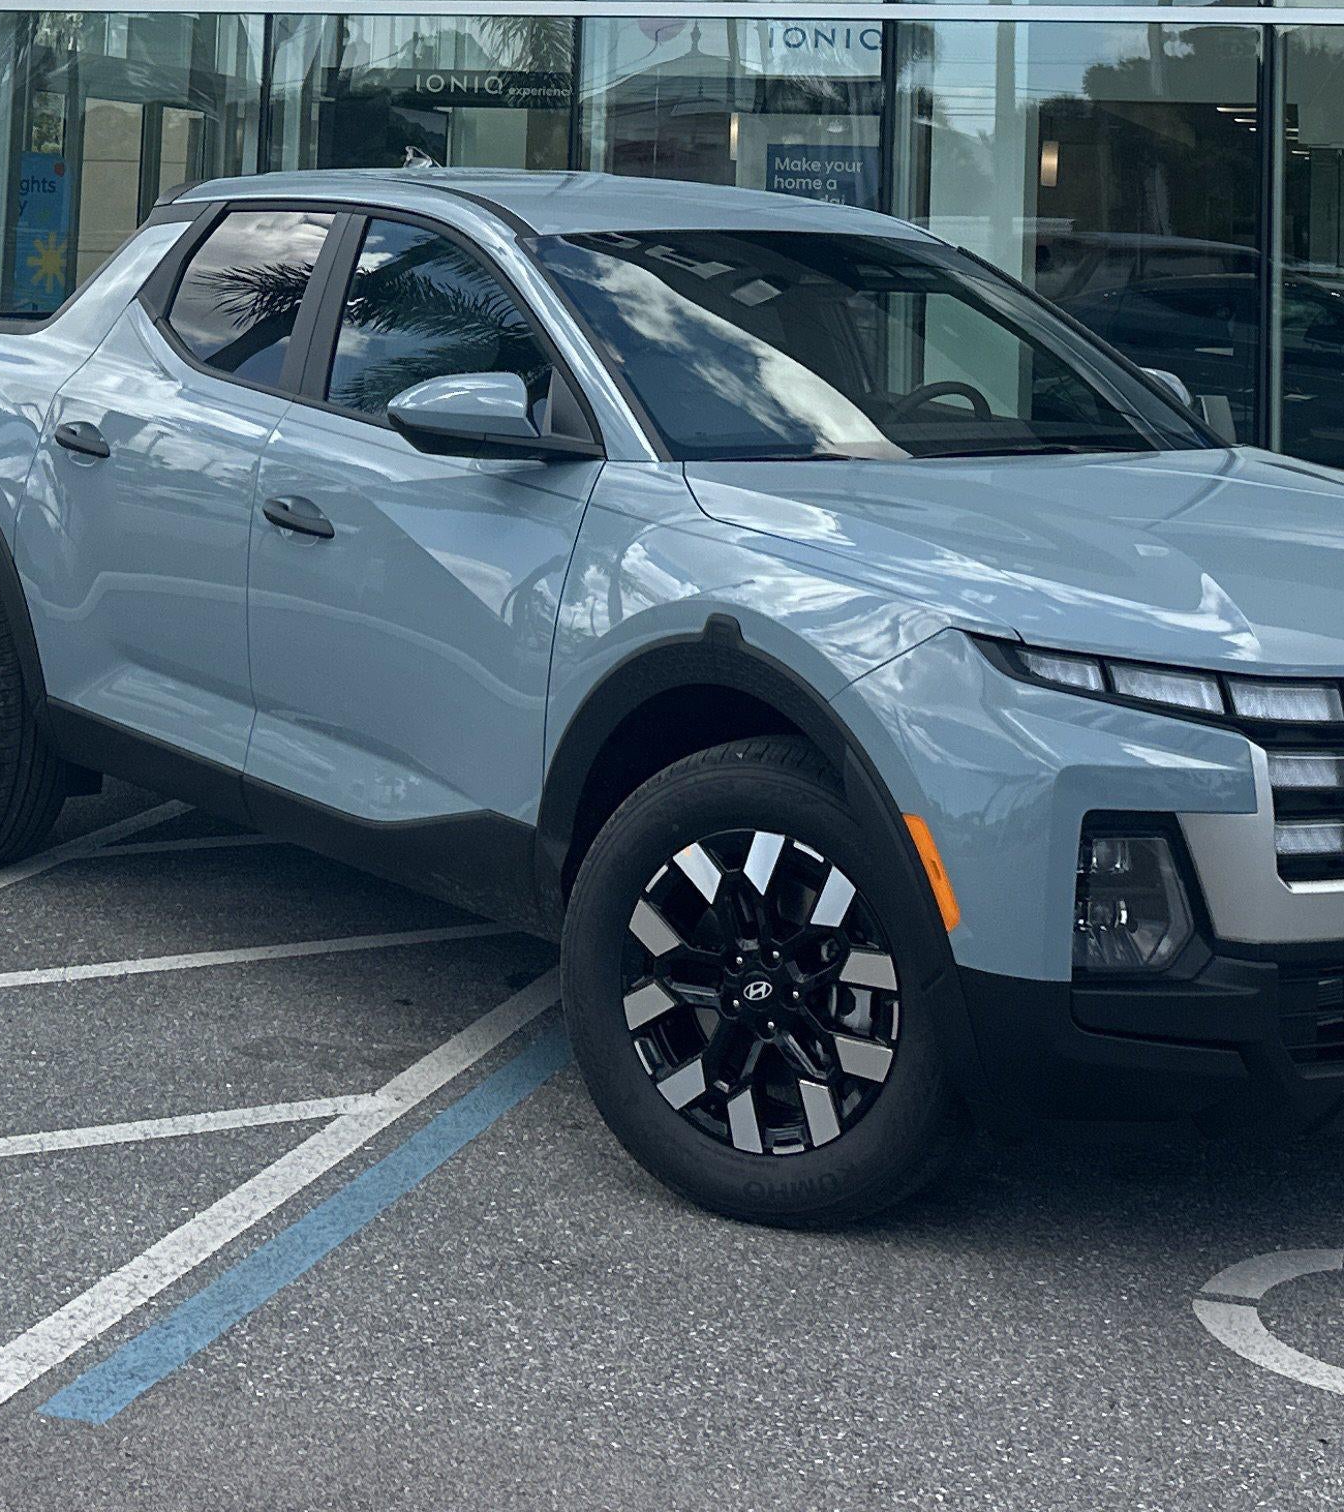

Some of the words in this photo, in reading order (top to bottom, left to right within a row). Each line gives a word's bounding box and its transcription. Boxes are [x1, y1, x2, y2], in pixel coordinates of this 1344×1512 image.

[415, 73, 504, 95] IONIQ
[507, 85, 572, 98] experienc
[774, 156, 822, 171] Make
[825, 161, 864, 174] your
[18, 175, 57, 196] ghts
[773, 174, 823, 190] home
[826, 179, 837, 190] a
